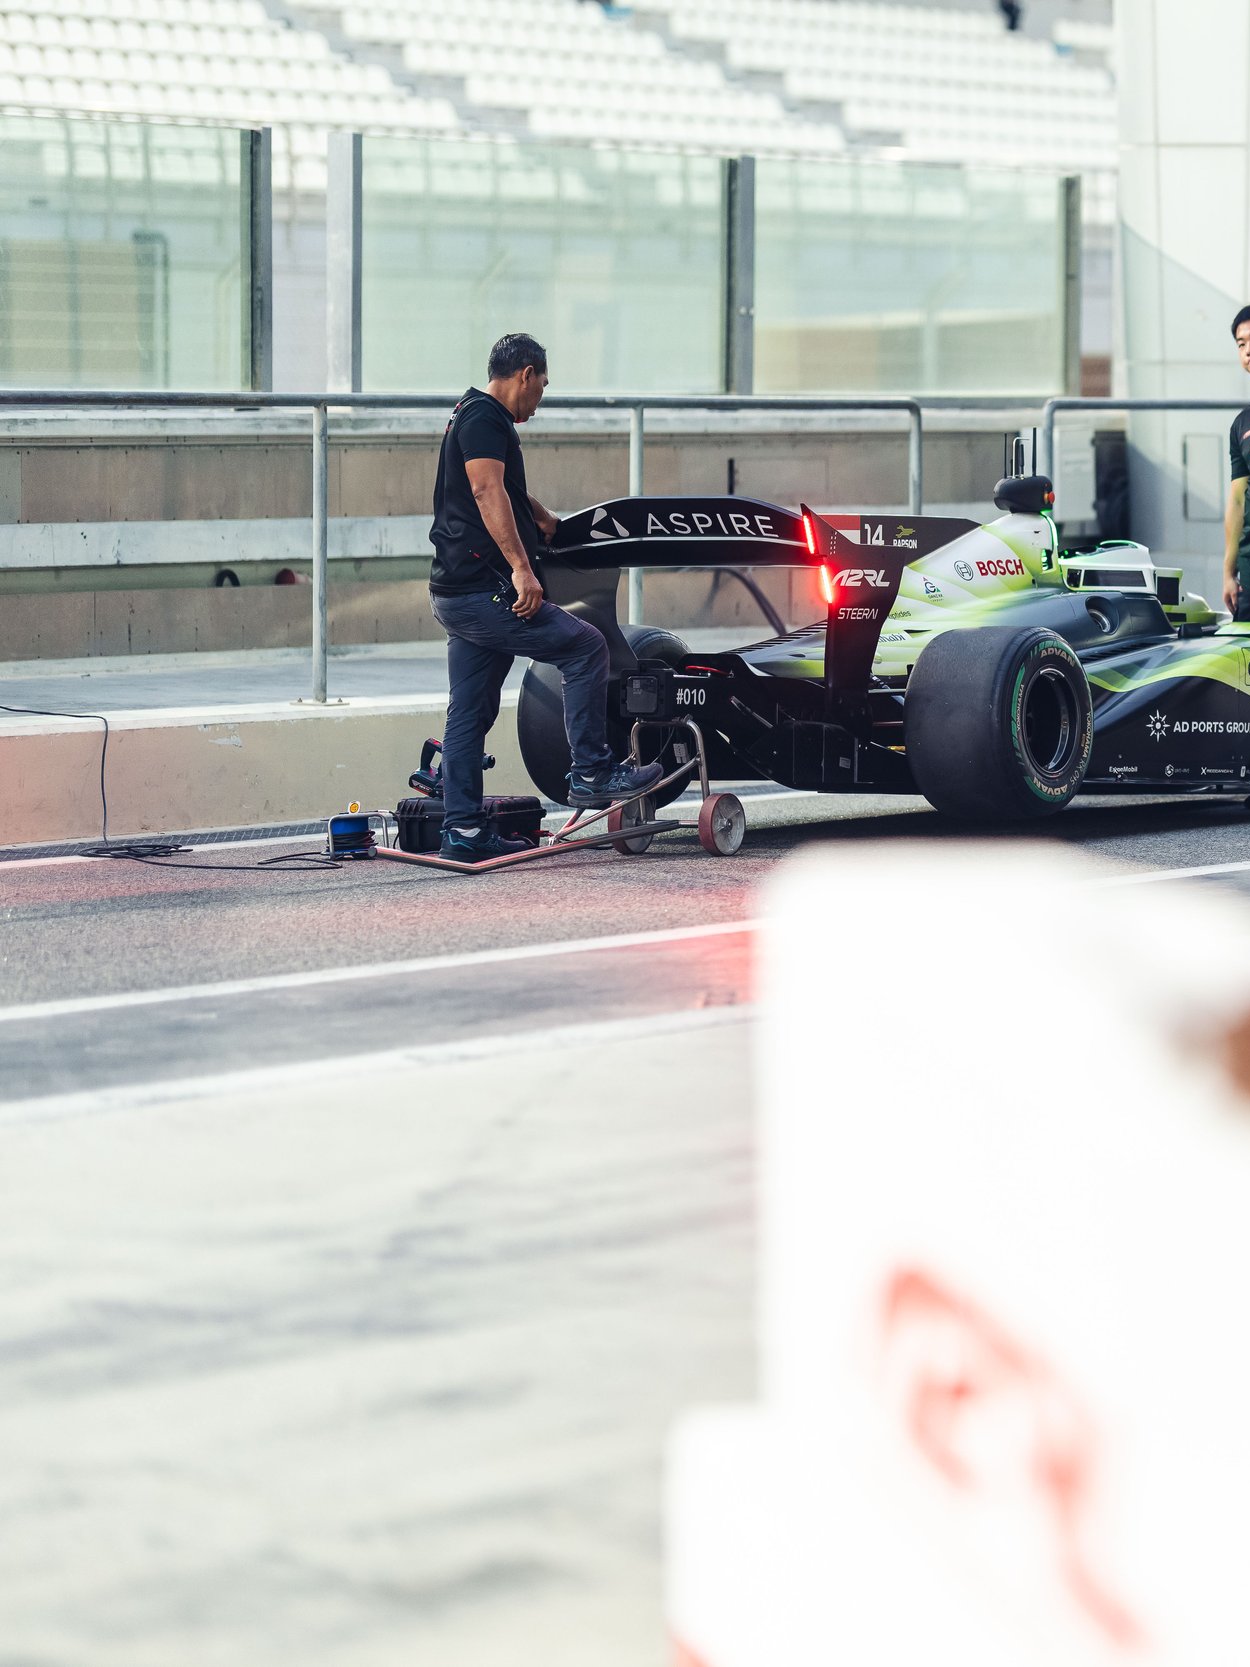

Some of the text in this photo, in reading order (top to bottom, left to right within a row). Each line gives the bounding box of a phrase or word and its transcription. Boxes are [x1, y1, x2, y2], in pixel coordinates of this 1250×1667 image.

[646, 512, 779, 538] ASPIRE
[864, 523, 885, 545] 14
[832, 568, 890, 587] A2RL
[975, 559, 1025, 577] BOSCH
[1040, 647, 1075, 667] ADVAN
[676, 688, 706, 706] #010
[1016, 684, 1024, 732] YOKOHAMA
[1082, 711, 1091, 758] YOKOHAMA
[1173, 721, 1189, 733] AD
[1191, 721, 1224, 733] PORTS
[1033, 776, 1068, 796] ADVAN
